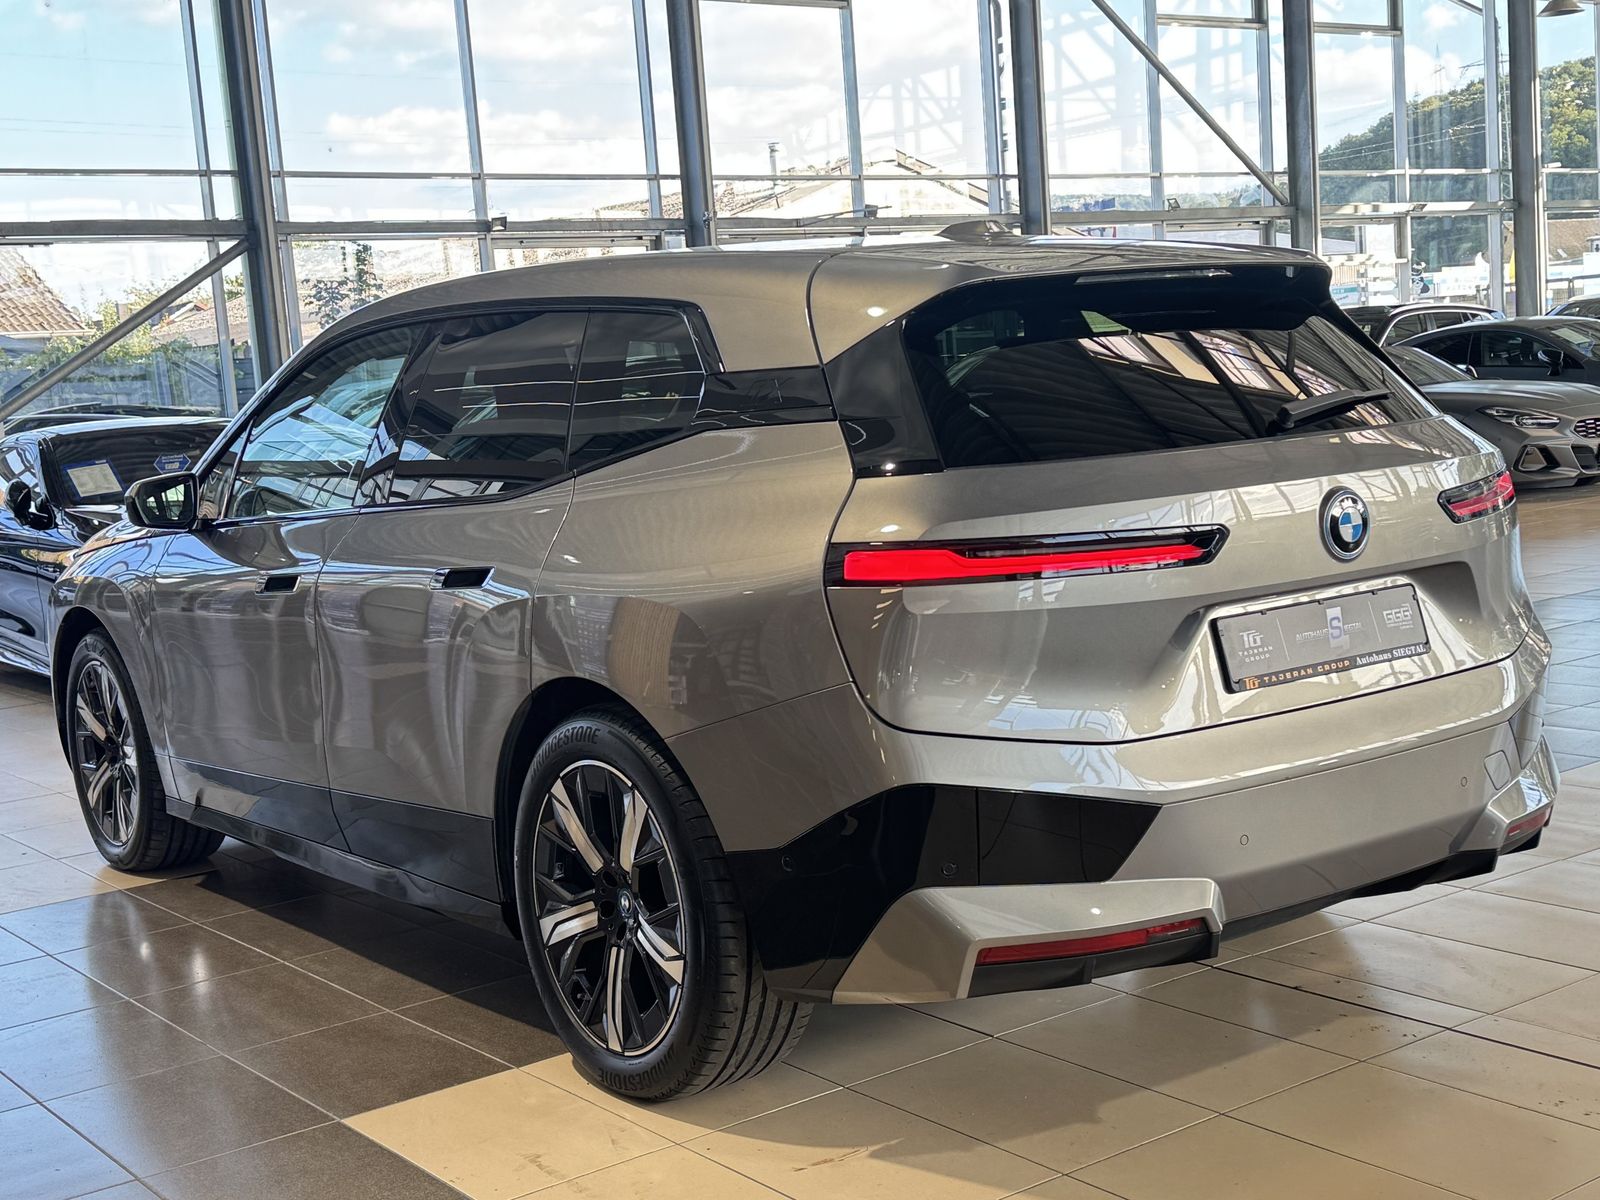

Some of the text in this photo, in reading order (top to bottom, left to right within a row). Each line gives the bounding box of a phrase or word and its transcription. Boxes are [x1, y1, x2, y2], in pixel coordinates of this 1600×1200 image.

[1238, 646, 1273, 656] TAJERAN
[1245, 653, 1270, 662] GROUP
[1263, 667, 1313, 683] TAJERAN
[1317, 660, 1350, 672] GROUP
[1356, 652, 1392, 666] Autohaus
[1392, 644, 1427, 657] SIEGTAL
